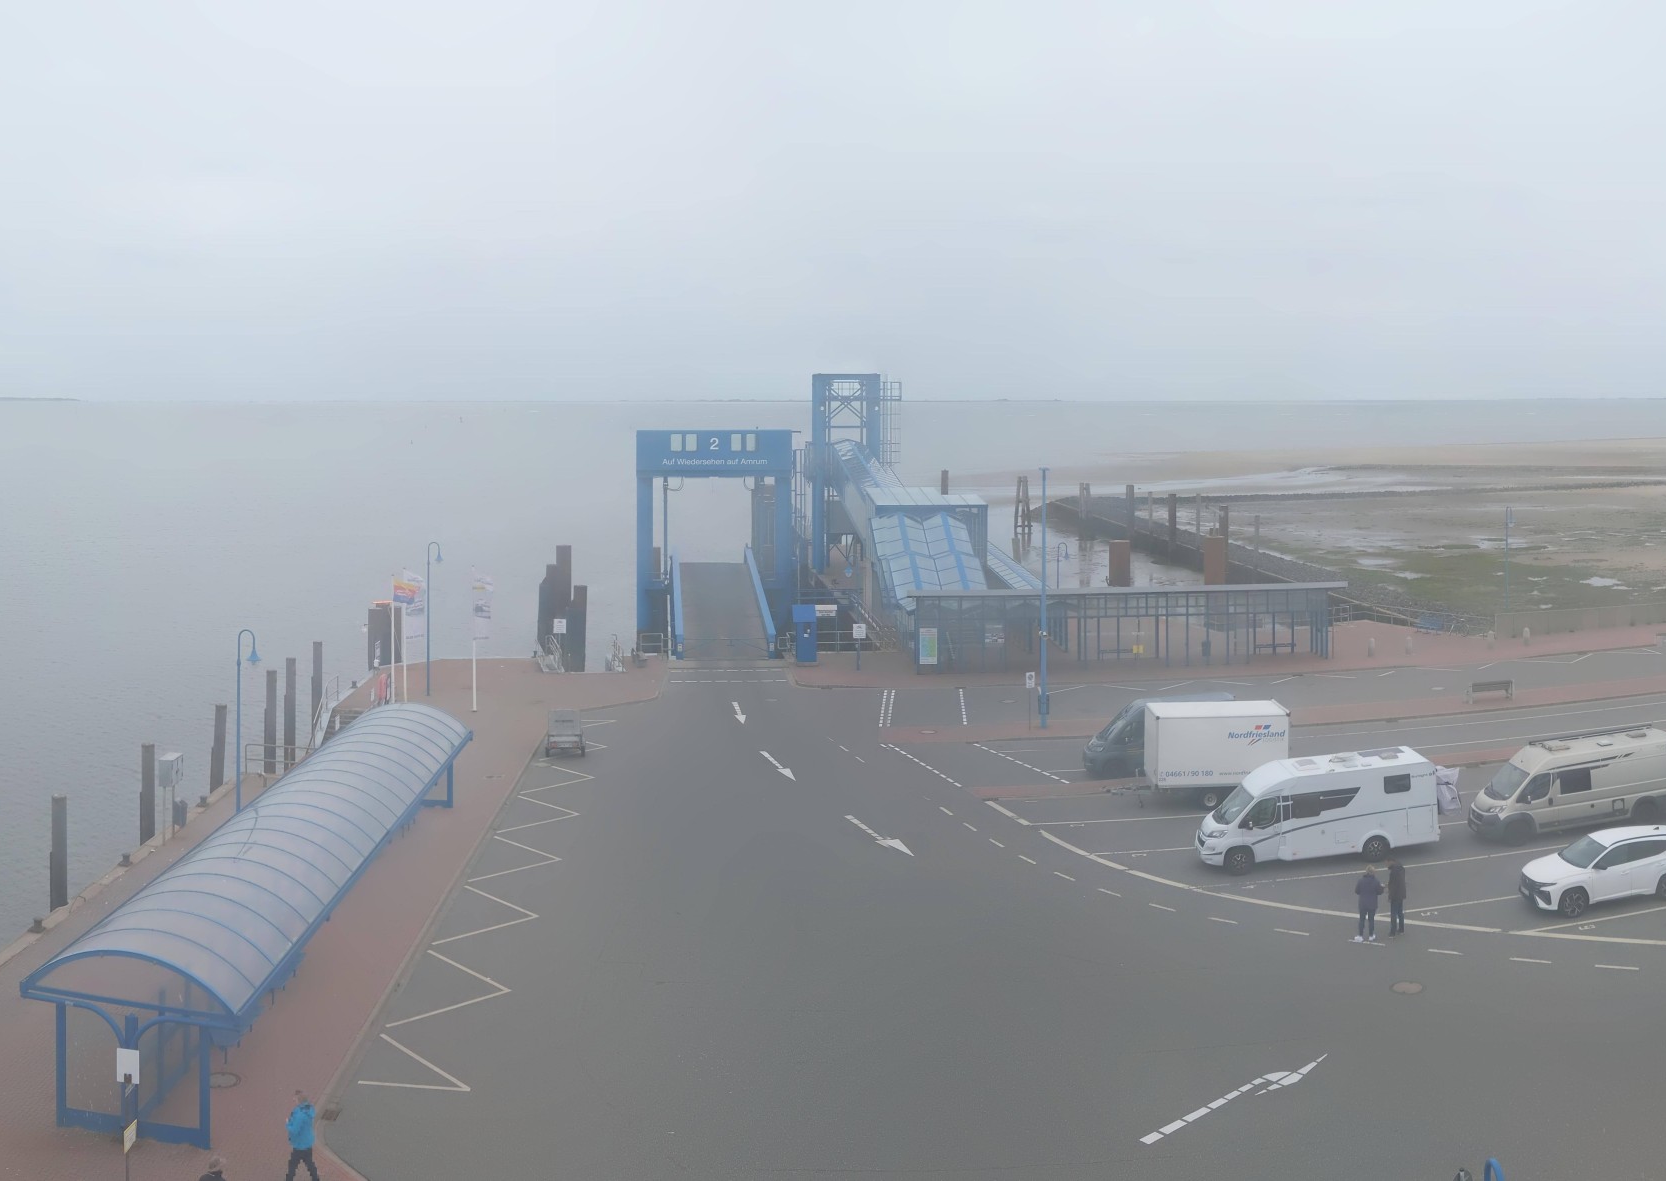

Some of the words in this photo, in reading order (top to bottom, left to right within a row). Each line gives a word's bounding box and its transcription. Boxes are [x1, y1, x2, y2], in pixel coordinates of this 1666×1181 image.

[709, 437, 720, 450] 2
[662, 458, 675, 466] Auf
[676, 458, 725, 466] Wiedersehen
[726, 458, 739, 466] auf
[740, 458, 768, 466] Amrum
[1227, 729, 1286, 739] Nordfriesland
